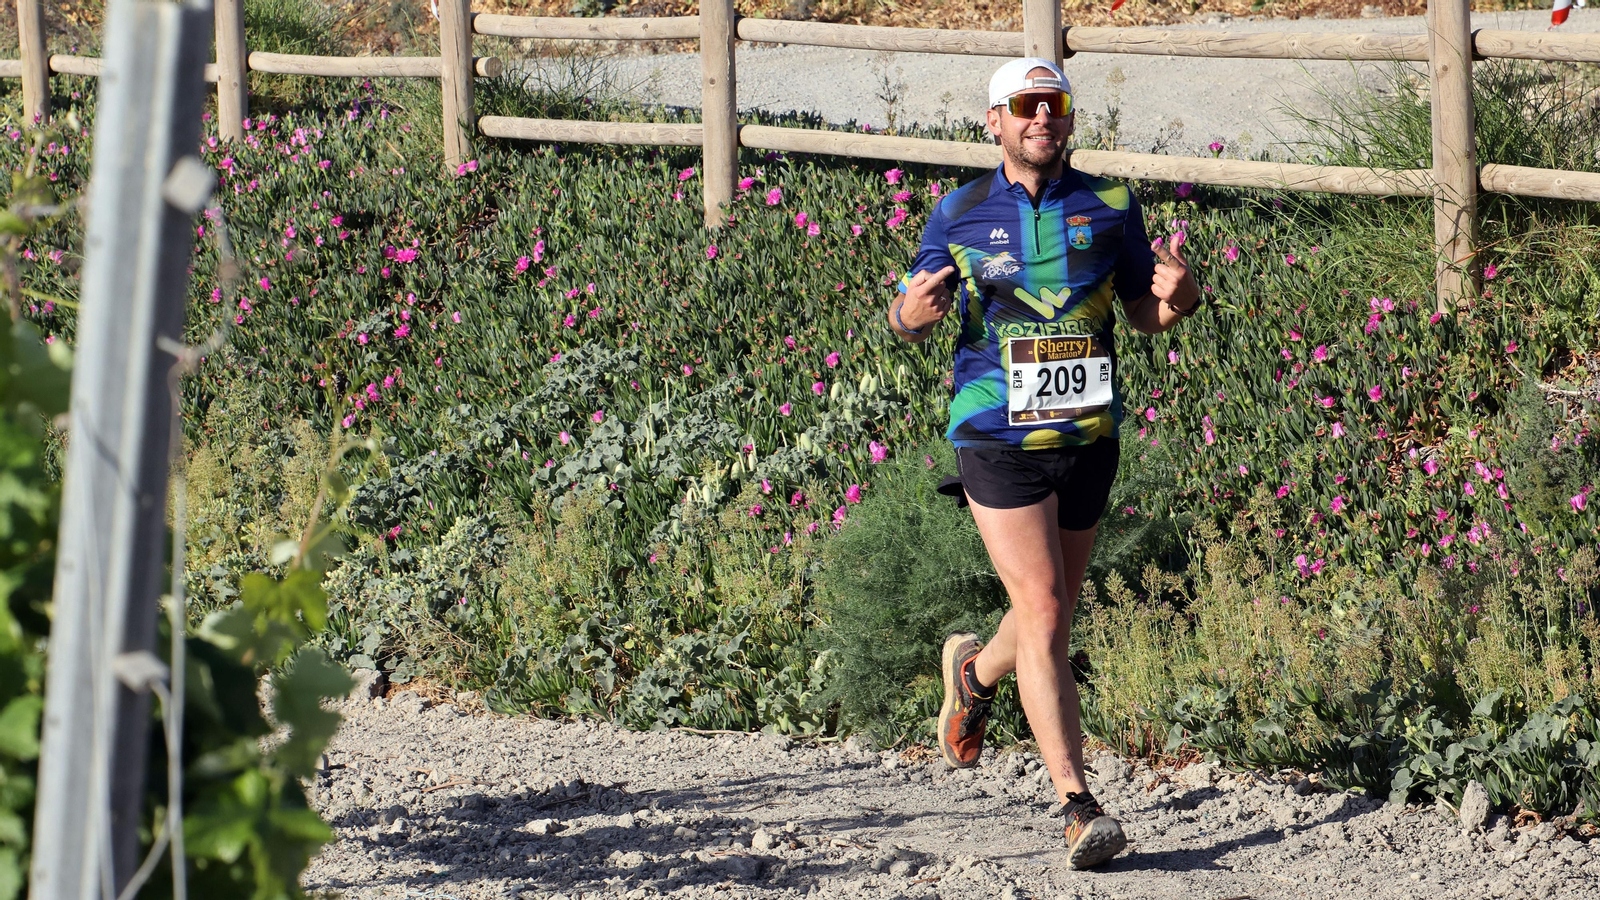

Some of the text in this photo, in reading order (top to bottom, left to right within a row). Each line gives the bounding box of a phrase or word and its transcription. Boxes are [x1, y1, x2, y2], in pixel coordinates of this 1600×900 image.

[1039, 339, 1086, 355] Sherry
[1047, 350, 1078, 360] Maraton
[1036, 364, 1087, 397] 209
